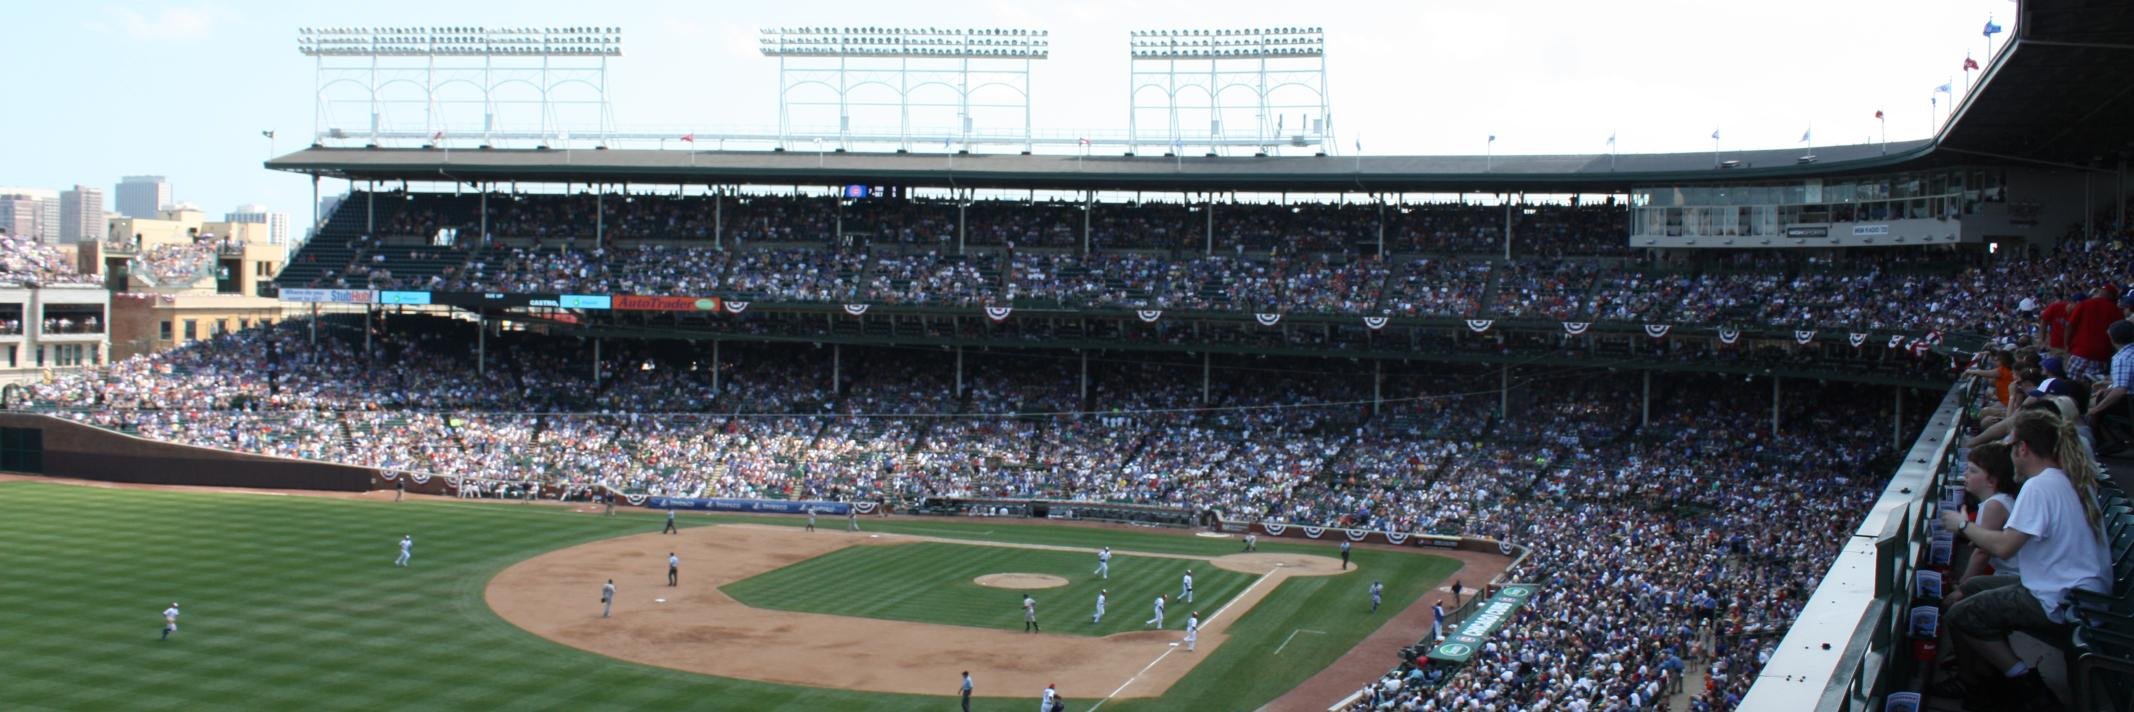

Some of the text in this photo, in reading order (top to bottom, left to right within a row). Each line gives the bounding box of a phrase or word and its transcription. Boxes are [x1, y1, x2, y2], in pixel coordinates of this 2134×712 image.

[331, 290, 373, 302] StubHub!
[618, 297, 693, 310] AutoTrader
[1462, 602, 1512, 636] CHICAGO CUBS
